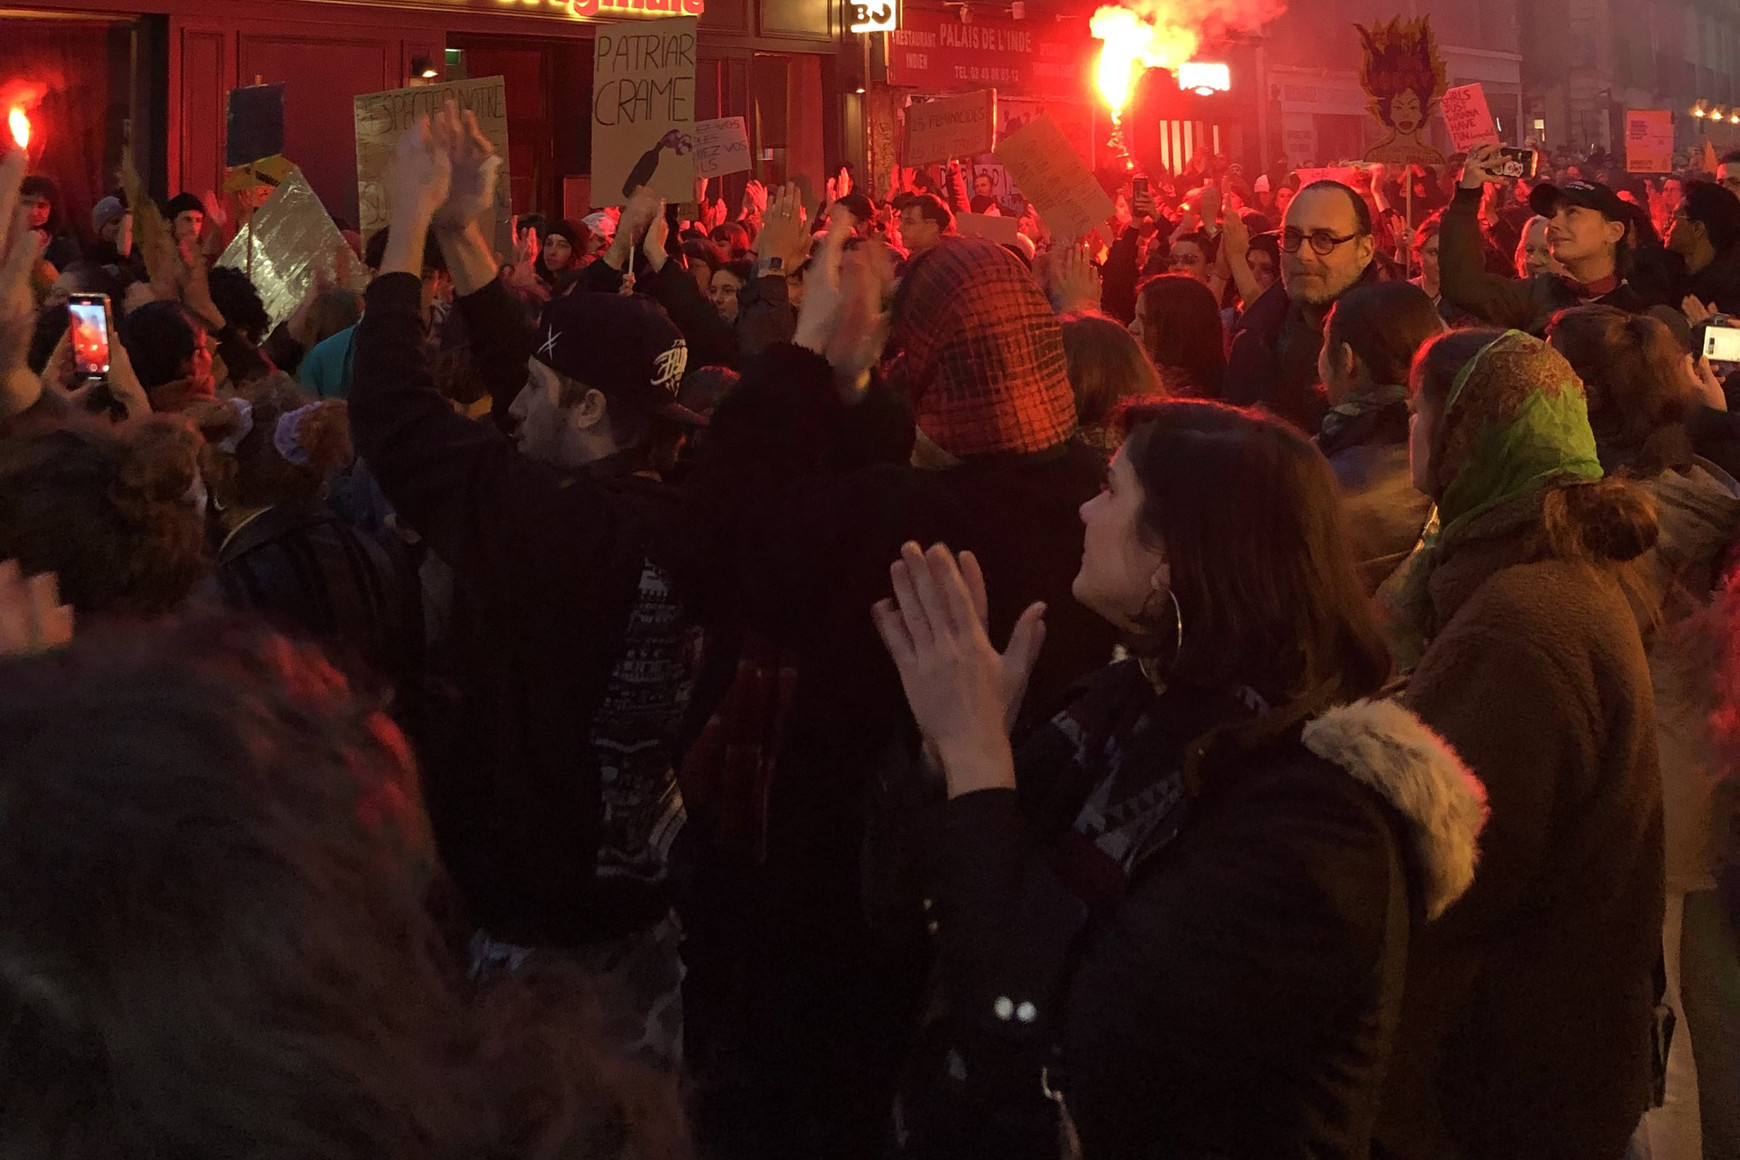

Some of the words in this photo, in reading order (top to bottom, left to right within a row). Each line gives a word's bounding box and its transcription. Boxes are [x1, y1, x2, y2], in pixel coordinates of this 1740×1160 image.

[895, 30, 936, 48] RESTAURANT
[940, 23, 979, 49] PALAIS
[982, 27, 996, 50] DE
[998, 29, 1032, 53] L'INDE
[905, 52, 928, 71] INDIEN
[594, 77, 693, 126] CRAME
[1443, 89, 1472, 105] GIRLS
[1444, 102, 1467, 114] JUST
[1446, 108, 1480, 123] WANNA
[1450, 118, 1477, 132] HAVE
